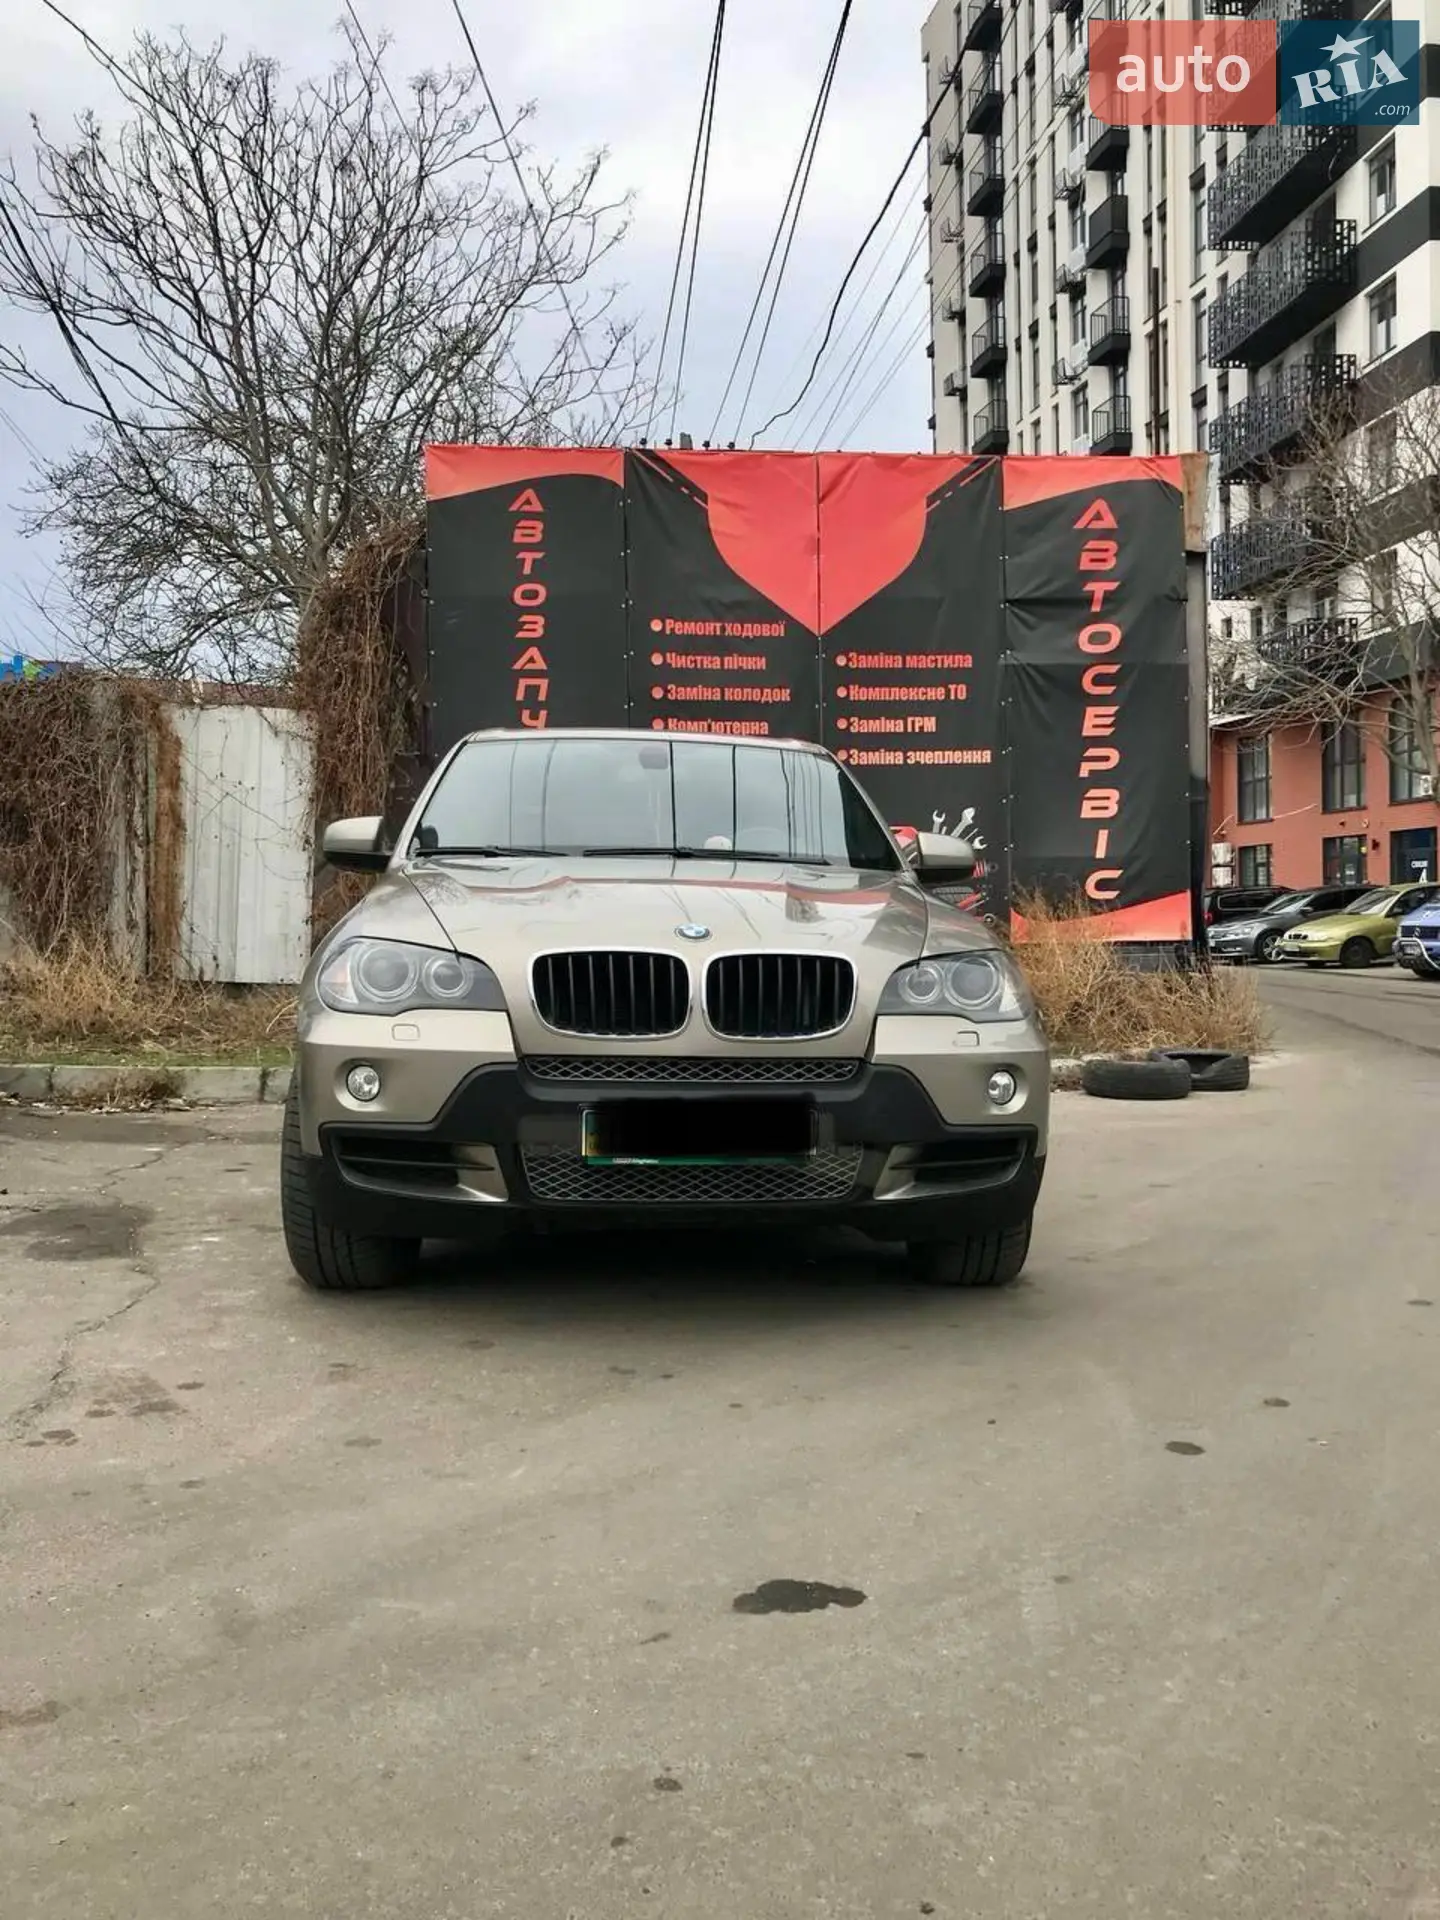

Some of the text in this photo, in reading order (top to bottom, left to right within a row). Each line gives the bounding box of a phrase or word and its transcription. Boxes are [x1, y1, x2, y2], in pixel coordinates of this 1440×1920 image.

[665, 620, 785, 638] Ремонт ходової
[666, 652, 766, 670] Чистка пічки
[849, 652, 973, 668] Заміна мастила
[667, 685, 791, 703] Заміна колодок
[849, 684, 967, 701] Комплексне ТО
[1073, 498, 1123, 900] АВТОСЕРВІС
[849, 716, 936, 733] Заміна ГРМ
[849, 749, 991, 766] Заміна зчеплення
